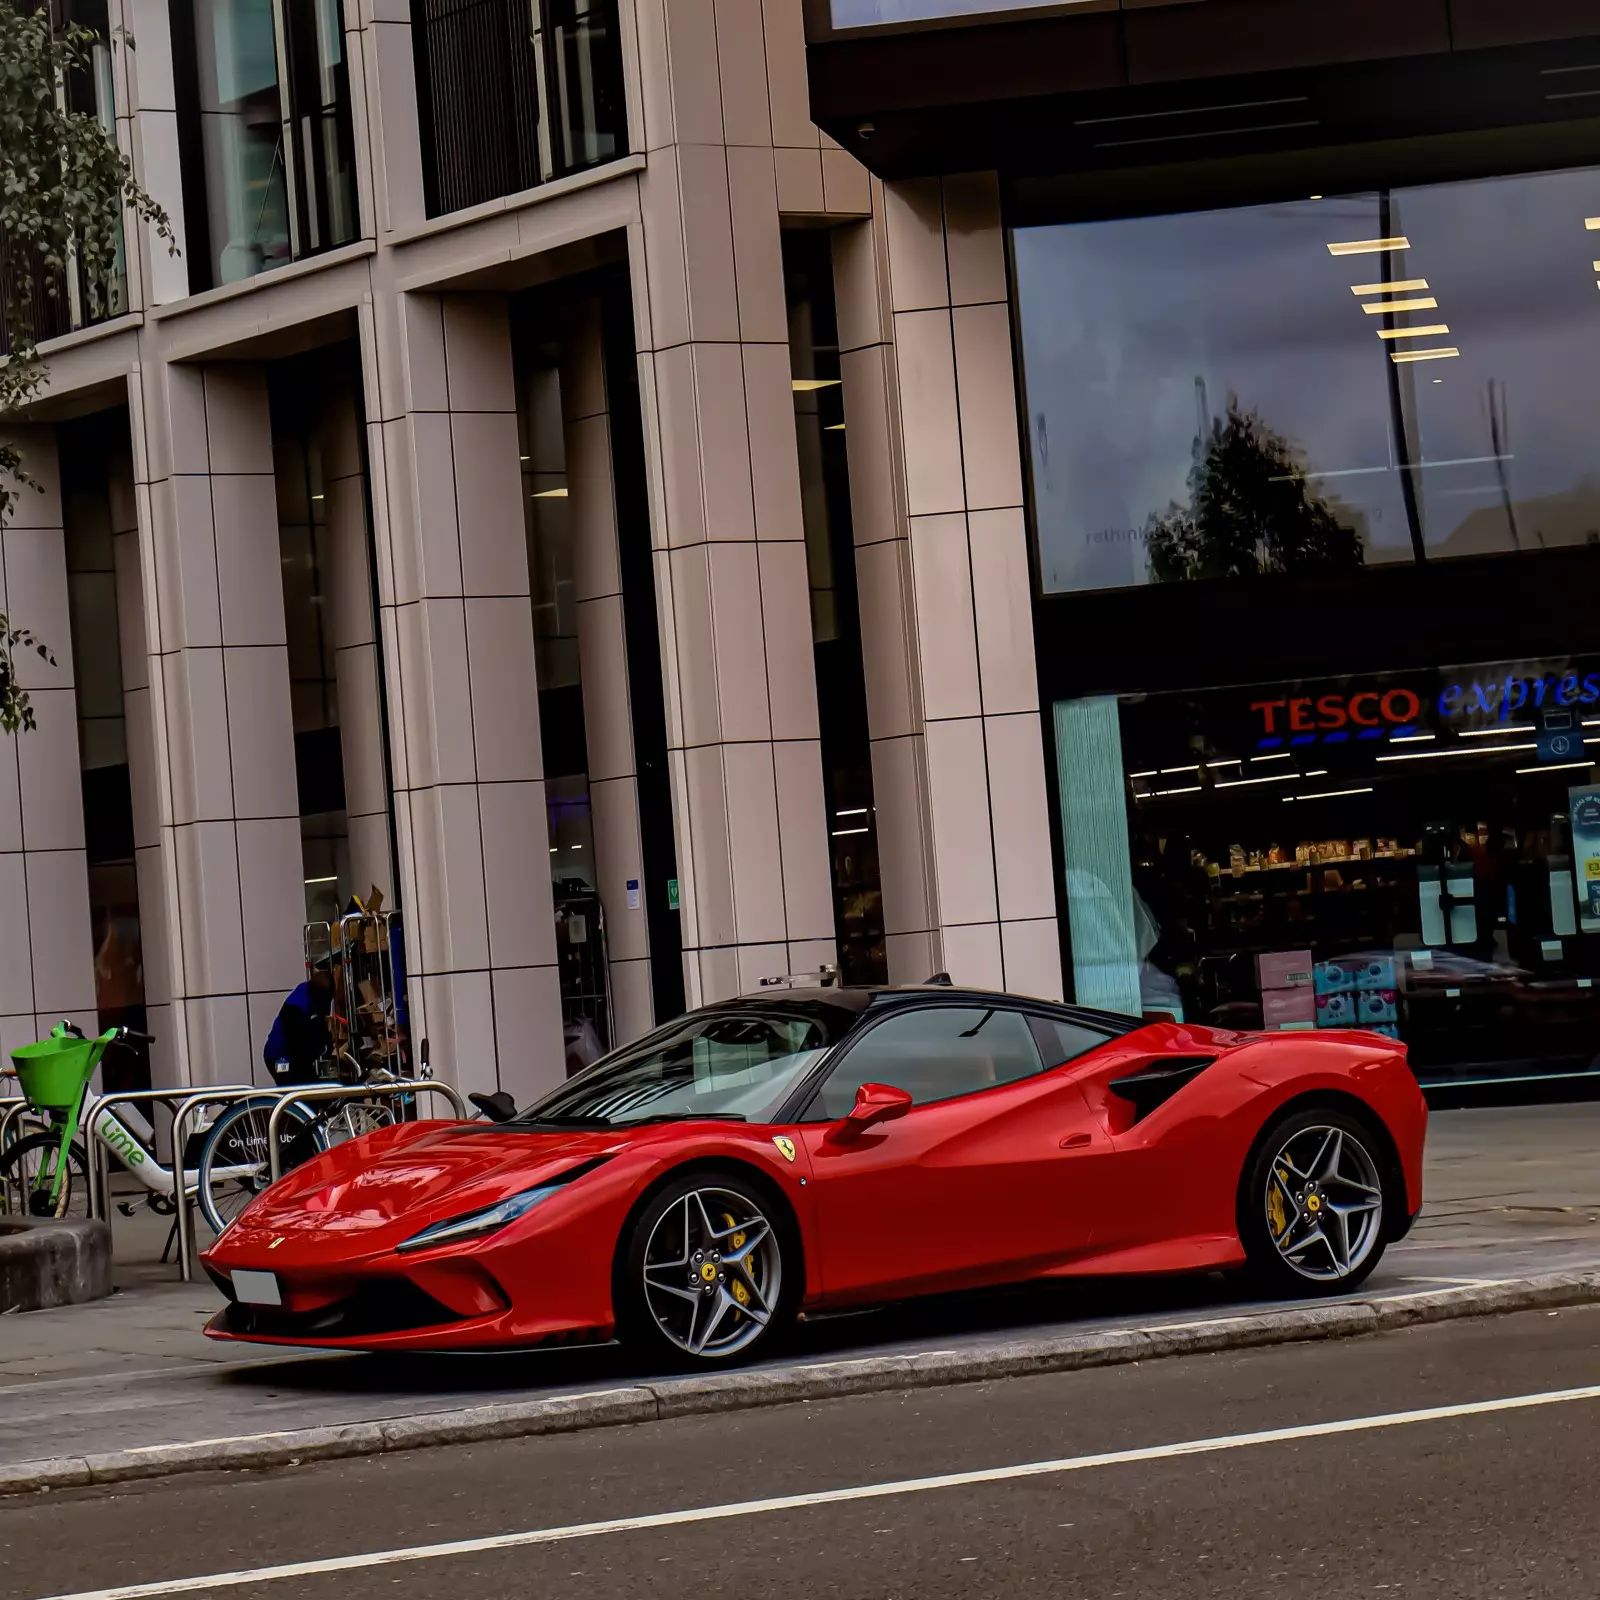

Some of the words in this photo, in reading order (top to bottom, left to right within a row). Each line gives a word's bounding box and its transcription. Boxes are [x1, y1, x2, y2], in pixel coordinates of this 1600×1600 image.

[1249, 688, 1420, 733] TESCO
[102, 1117, 145, 1167] Lime
[229, 1139, 244, 1148] On
